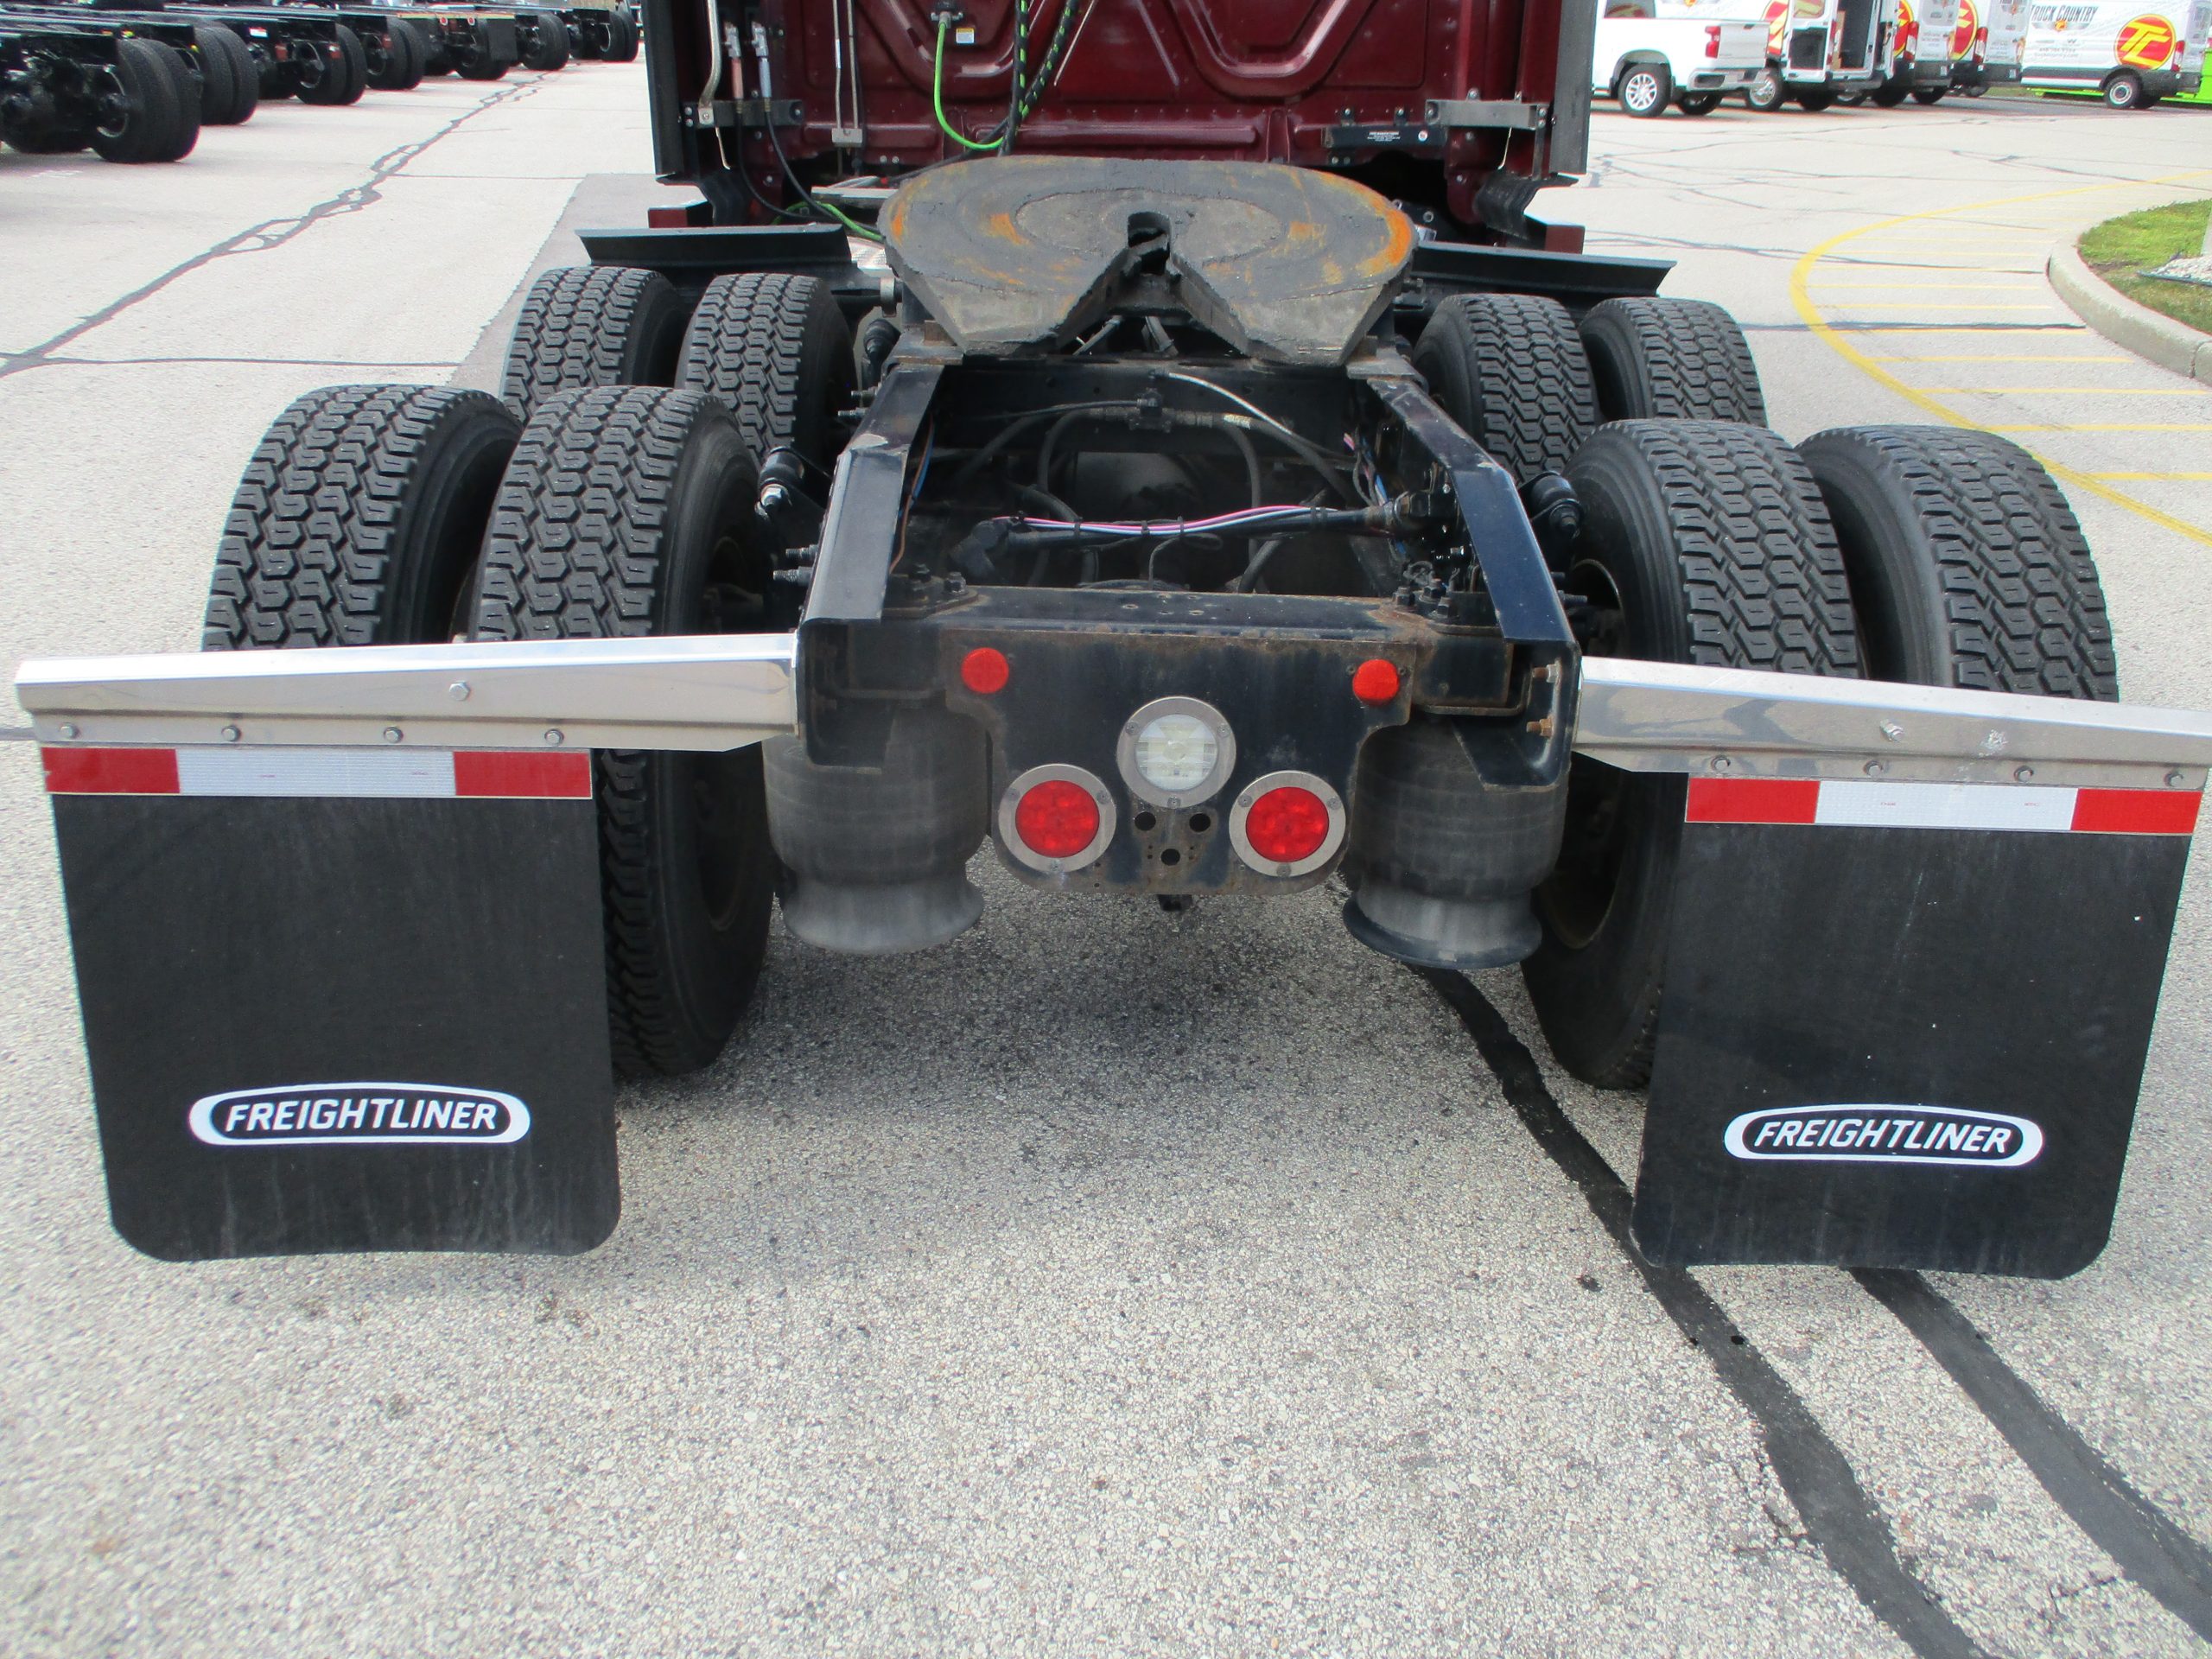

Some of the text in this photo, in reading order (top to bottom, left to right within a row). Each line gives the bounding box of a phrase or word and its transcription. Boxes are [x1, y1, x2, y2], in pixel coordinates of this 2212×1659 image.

[2056, 4, 2099, 22] COUNTRY
[226, 1098, 497, 1132] FREIGHTLINER
[1754, 1119, 2012, 1154] FREIGHTLINER
